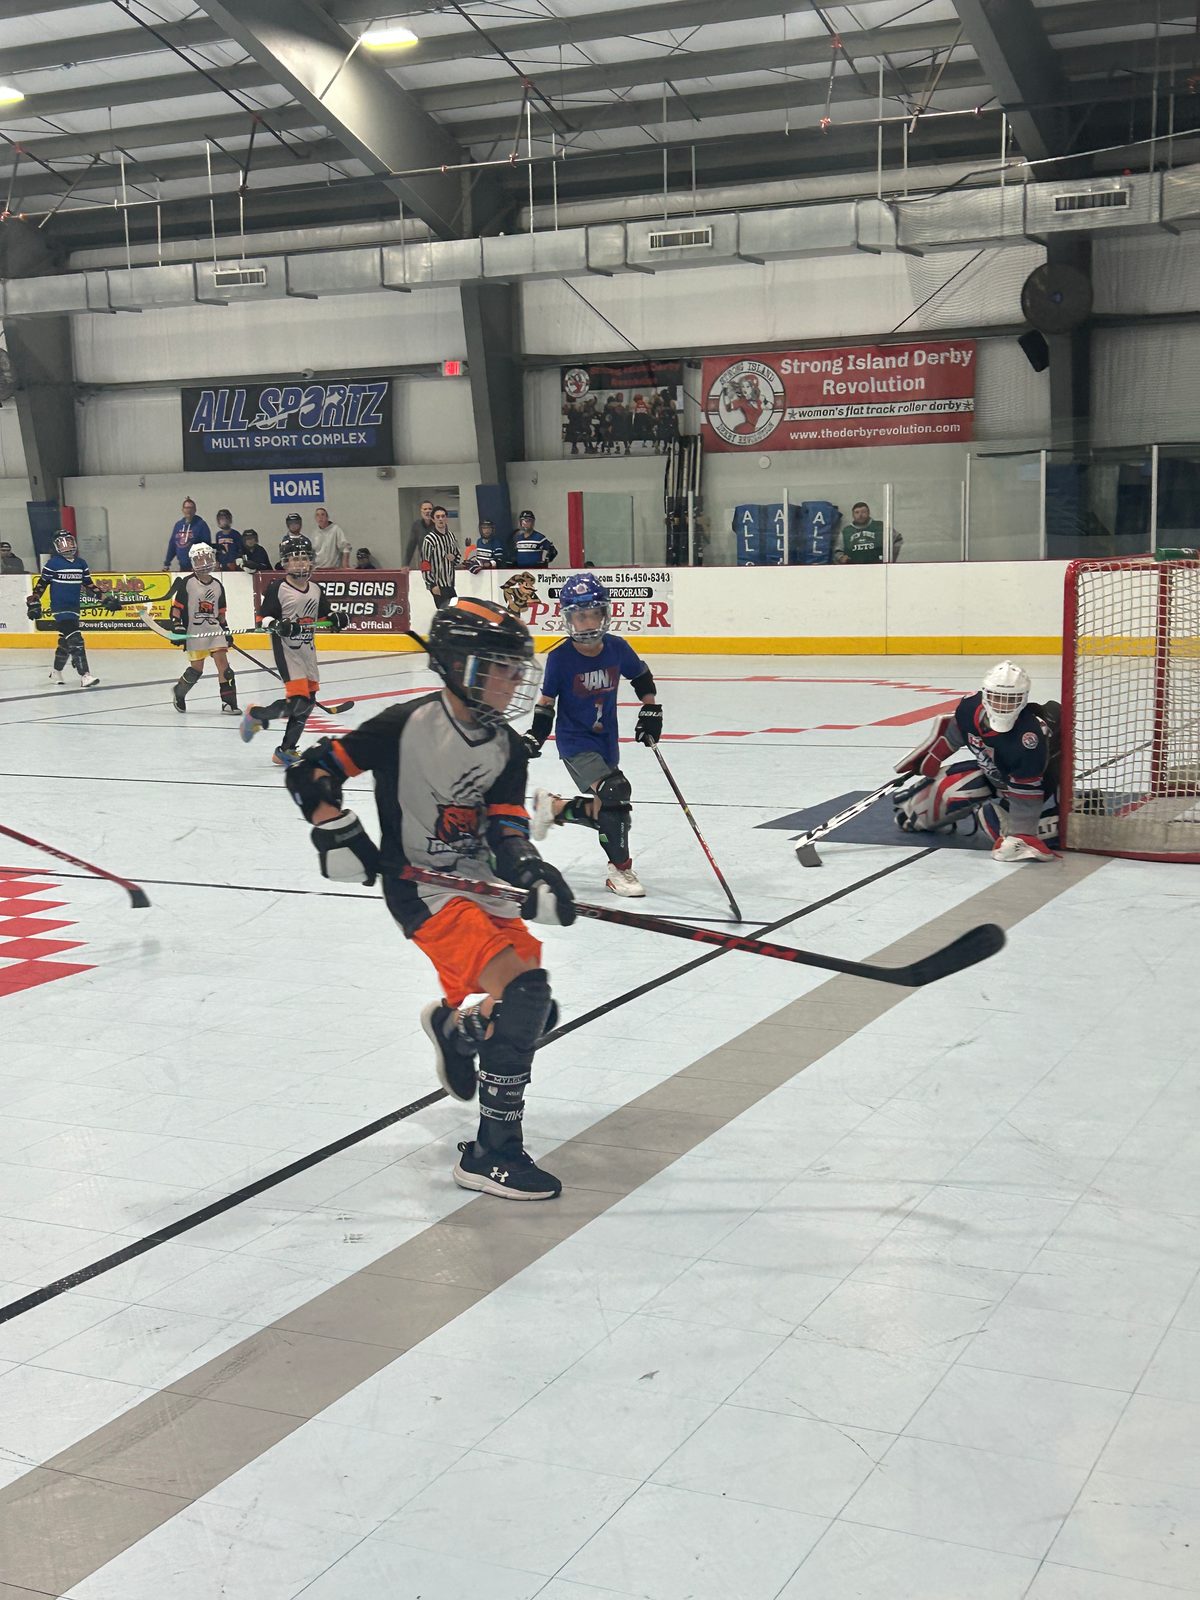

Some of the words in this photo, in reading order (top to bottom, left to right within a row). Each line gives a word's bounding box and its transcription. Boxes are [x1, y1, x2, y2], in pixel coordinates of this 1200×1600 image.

[780, 356, 844, 375] Strong
[847, 351, 910, 370] Island
[913, 347, 974, 366] Derby
[822, 375, 925, 396] Revolution
[189, 389, 250, 432] ALL
[249, 382, 389, 431] SPORTZ
[798, 406, 844, 419] women's
[845, 406, 864, 418] flat
[866, 403, 895, 415] track
[897, 401, 928, 413] roller
[929, 400, 962, 412] derby
[211, 435, 250, 449] MULTI
[253, 434, 298, 448] SPORT
[301, 431, 367, 446] COMPLEX
[789, 422, 961, 440] www.thederbyrevolution.com
[273, 479, 321, 497] HOME
[852, 543, 875, 551] JETS
[349, 581, 395, 596] SIGNS
[608, 588, 648, 598] PROGRAMS
[119, 594, 136, 602] East
